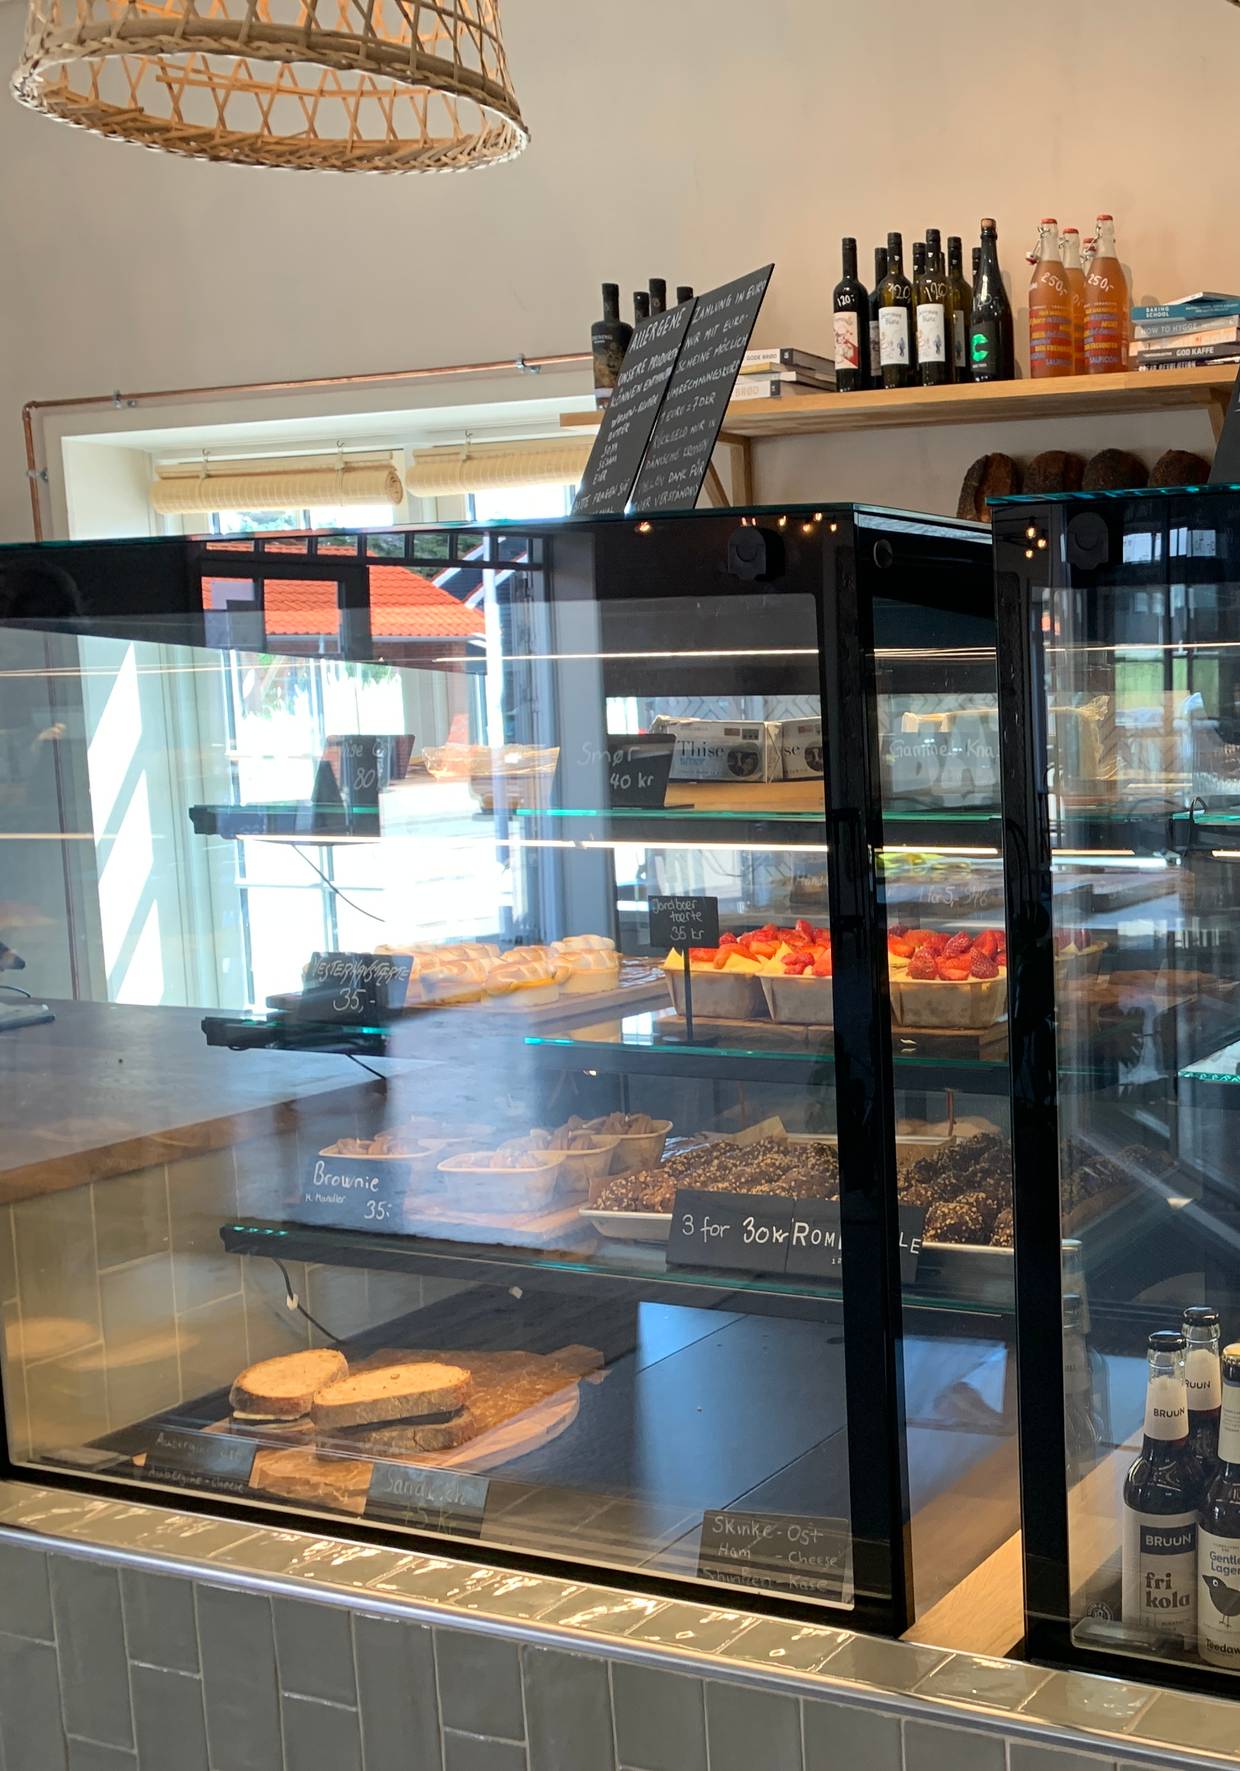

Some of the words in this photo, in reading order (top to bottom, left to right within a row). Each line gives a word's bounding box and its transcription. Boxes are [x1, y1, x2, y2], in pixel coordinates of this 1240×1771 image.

[1192, 346, 1215, 355] KAFFE
[610, 772, 632, 789] 40
[638, 772, 654, 788] kr
[670, 926, 687, 940] 35
[313, 1160, 379, 1192] Brownie
[682, 1214, 694, 1236] 3
[700, 1216, 730, 1243] for
[1185, 1380, 1211, 1389] RUUN
[1153, 1408, 1185, 1418] BRUUN
[1145, 1534, 1191, 1547] BRUUN
[1145, 1572, 1172, 1590] fri
[1145, 1591, 1190, 1609] kola
